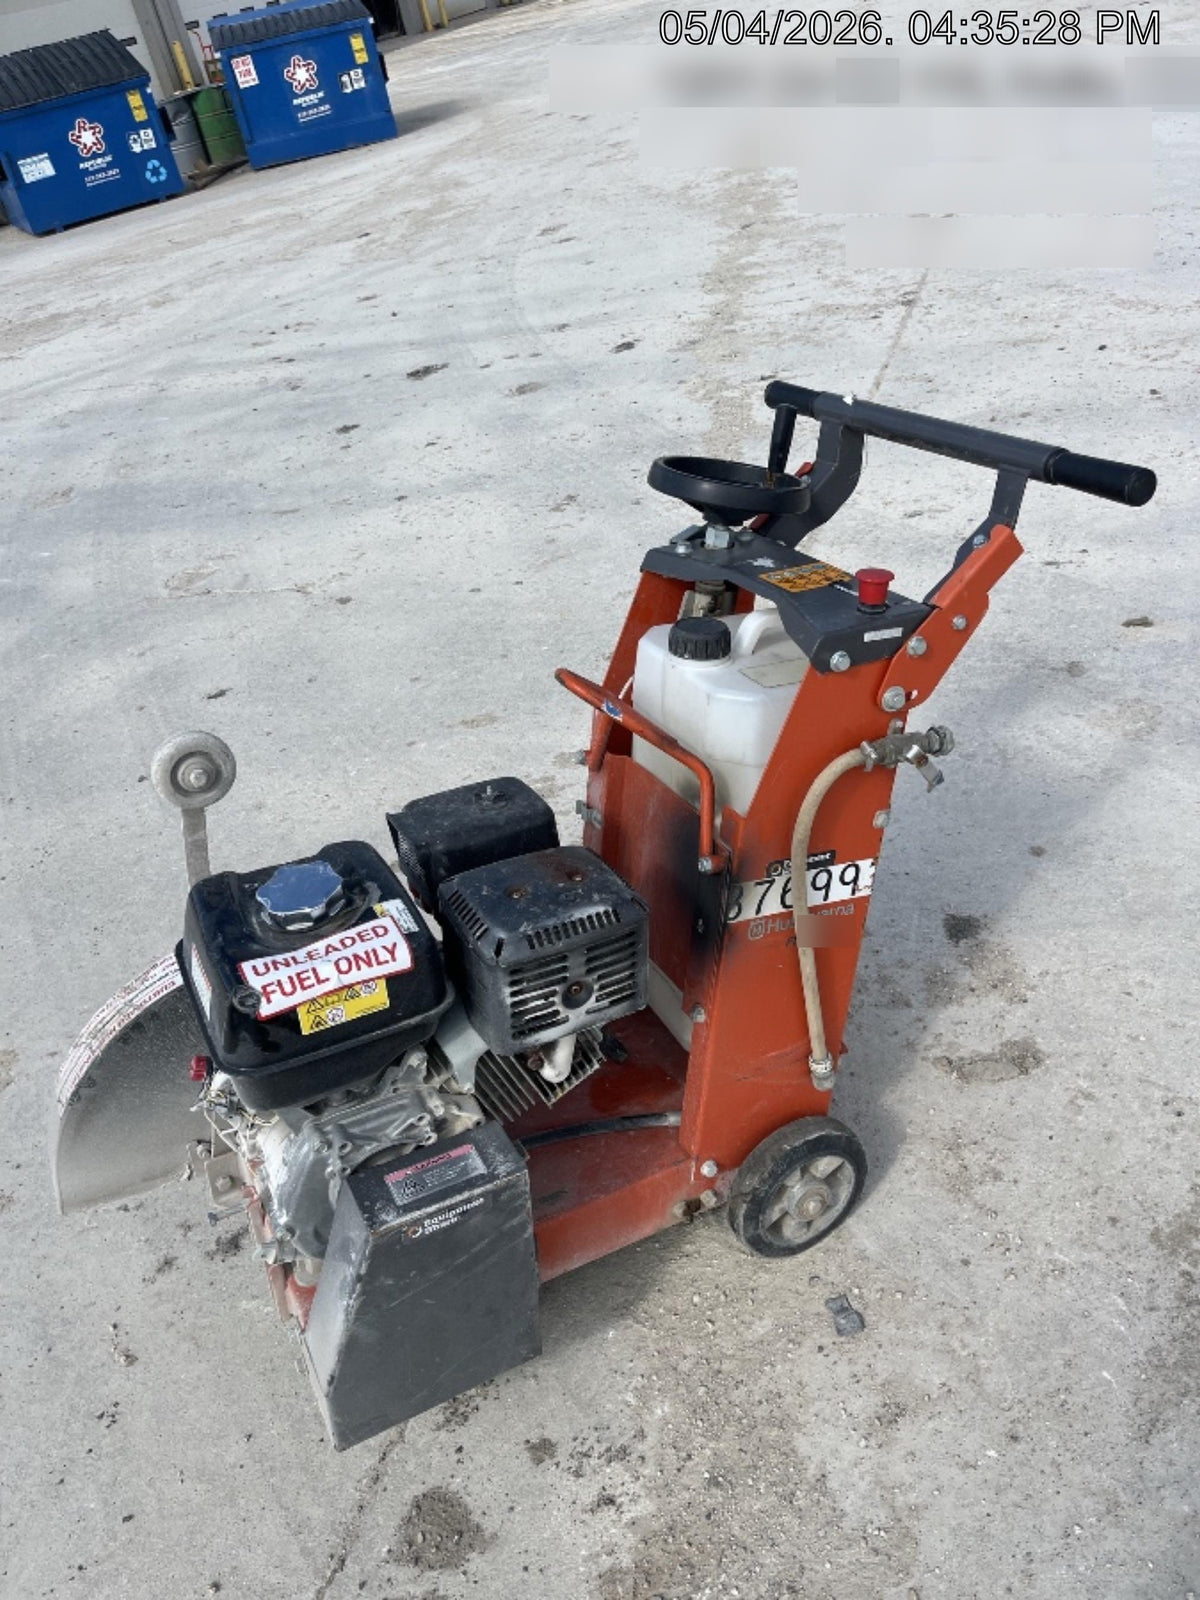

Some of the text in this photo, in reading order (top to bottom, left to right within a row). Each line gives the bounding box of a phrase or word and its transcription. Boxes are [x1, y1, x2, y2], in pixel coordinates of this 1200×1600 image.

[251, 924, 390, 978] UNLEADED
[260, 942, 399, 1005] FUEL ONLY
